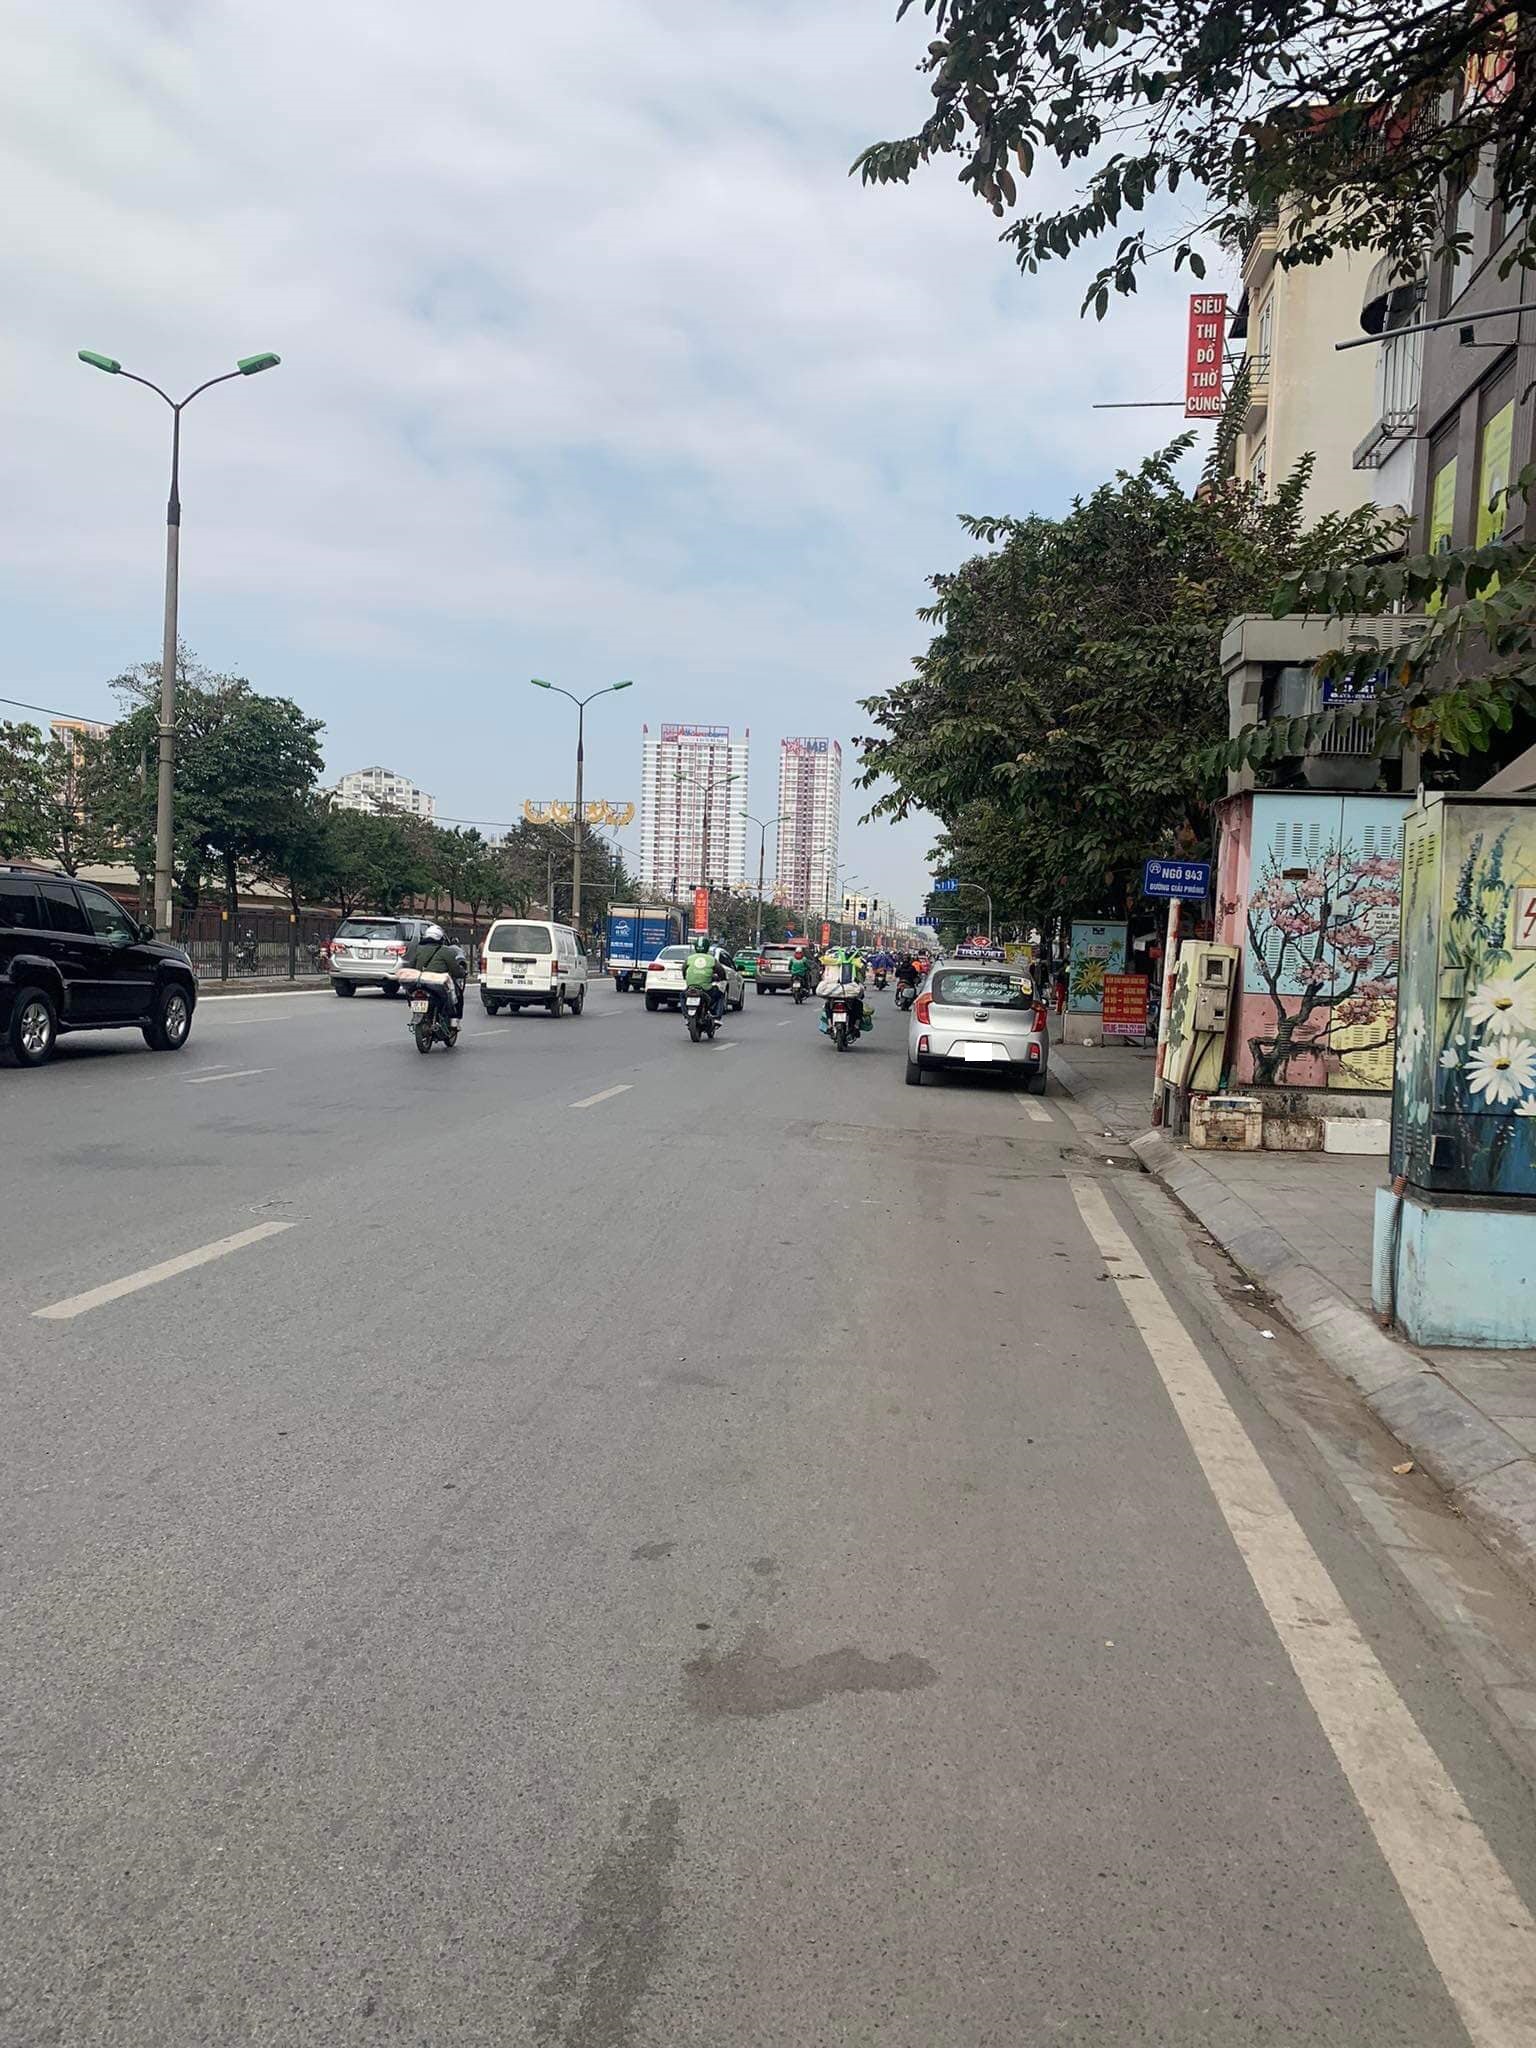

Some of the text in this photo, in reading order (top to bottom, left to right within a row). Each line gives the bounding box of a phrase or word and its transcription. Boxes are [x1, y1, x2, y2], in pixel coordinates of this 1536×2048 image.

[1193, 295, 1222, 314] SIÊU
[1196, 323, 1217, 342] THỊ
[1196, 342, 1215, 363] ĐỒ
[1191, 367, 1219, 387] THỜ
[1187, 392, 1220, 411] CÚNG
[1161, 866, 1203, 880] NGÕ 943
